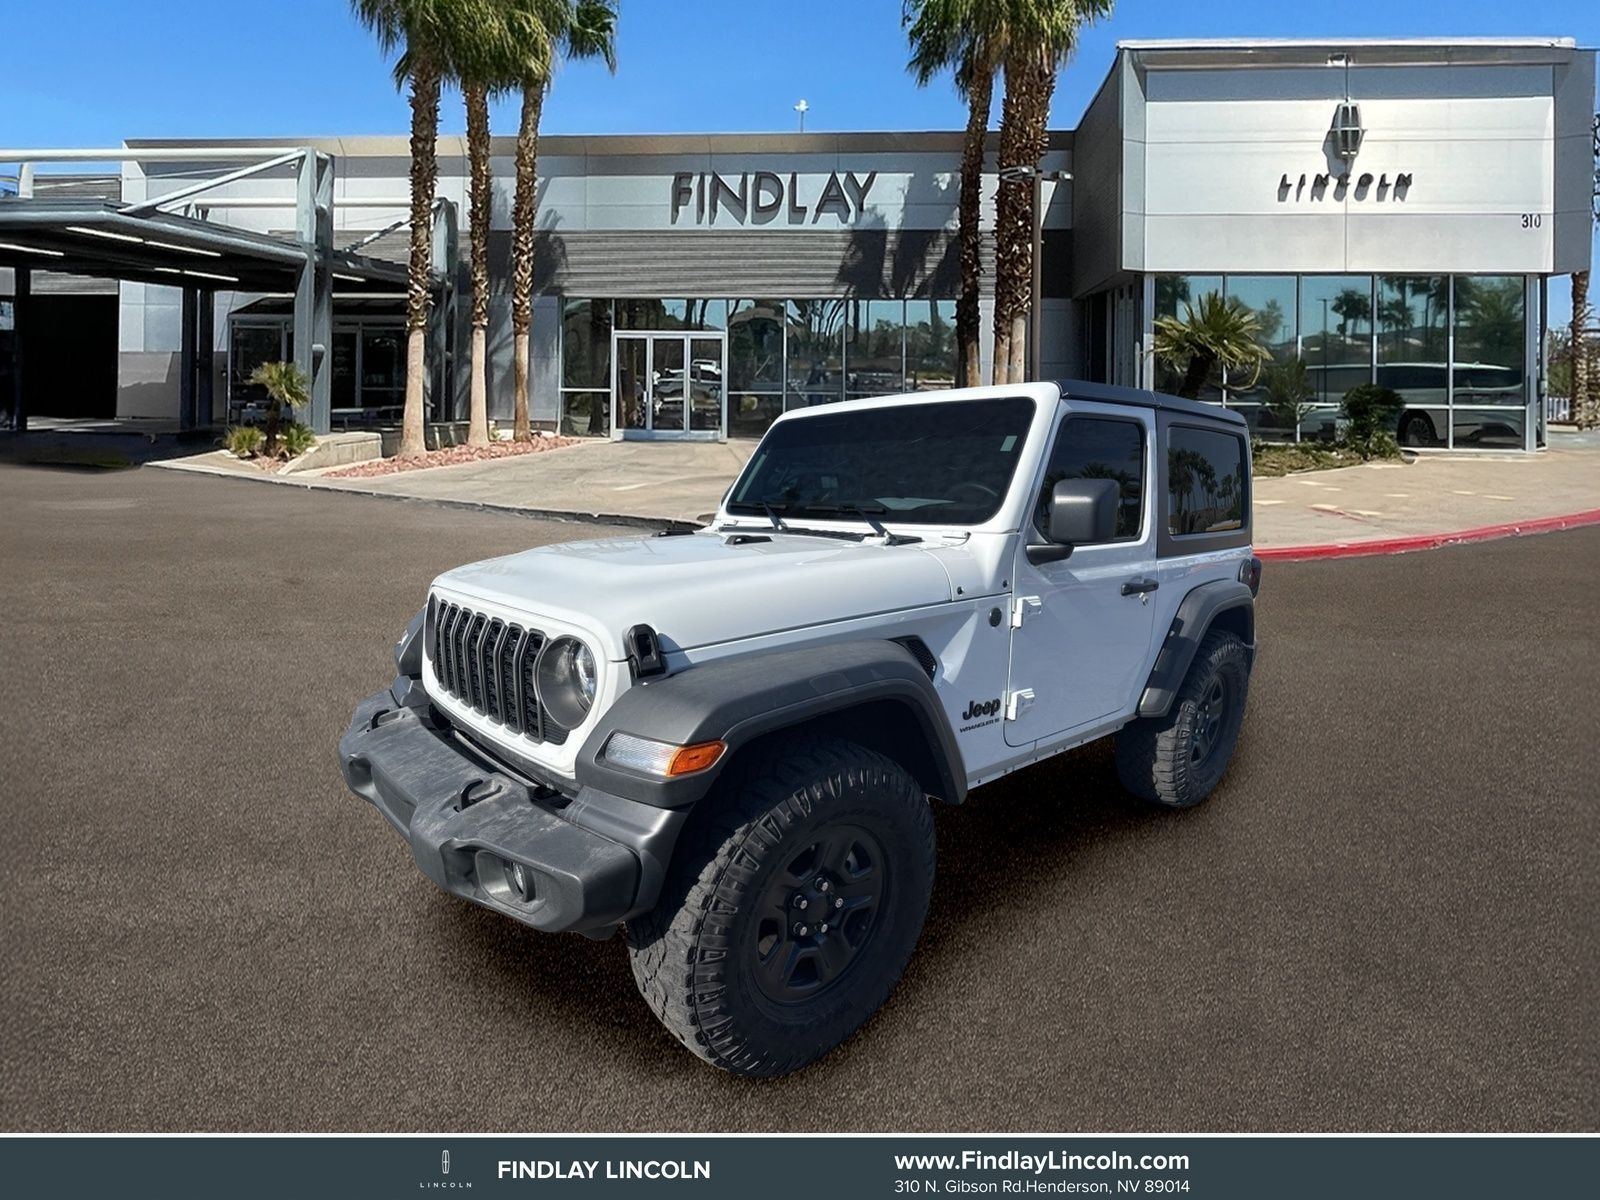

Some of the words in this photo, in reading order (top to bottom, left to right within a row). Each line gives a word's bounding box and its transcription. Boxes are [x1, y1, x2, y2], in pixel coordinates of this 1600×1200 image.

[1278, 172, 1413, 197] LINCOLN
[671, 170, 877, 223] FINDLAY
[1521, 214, 1542, 229] 310
[962, 698, 1001, 720] Jeep
